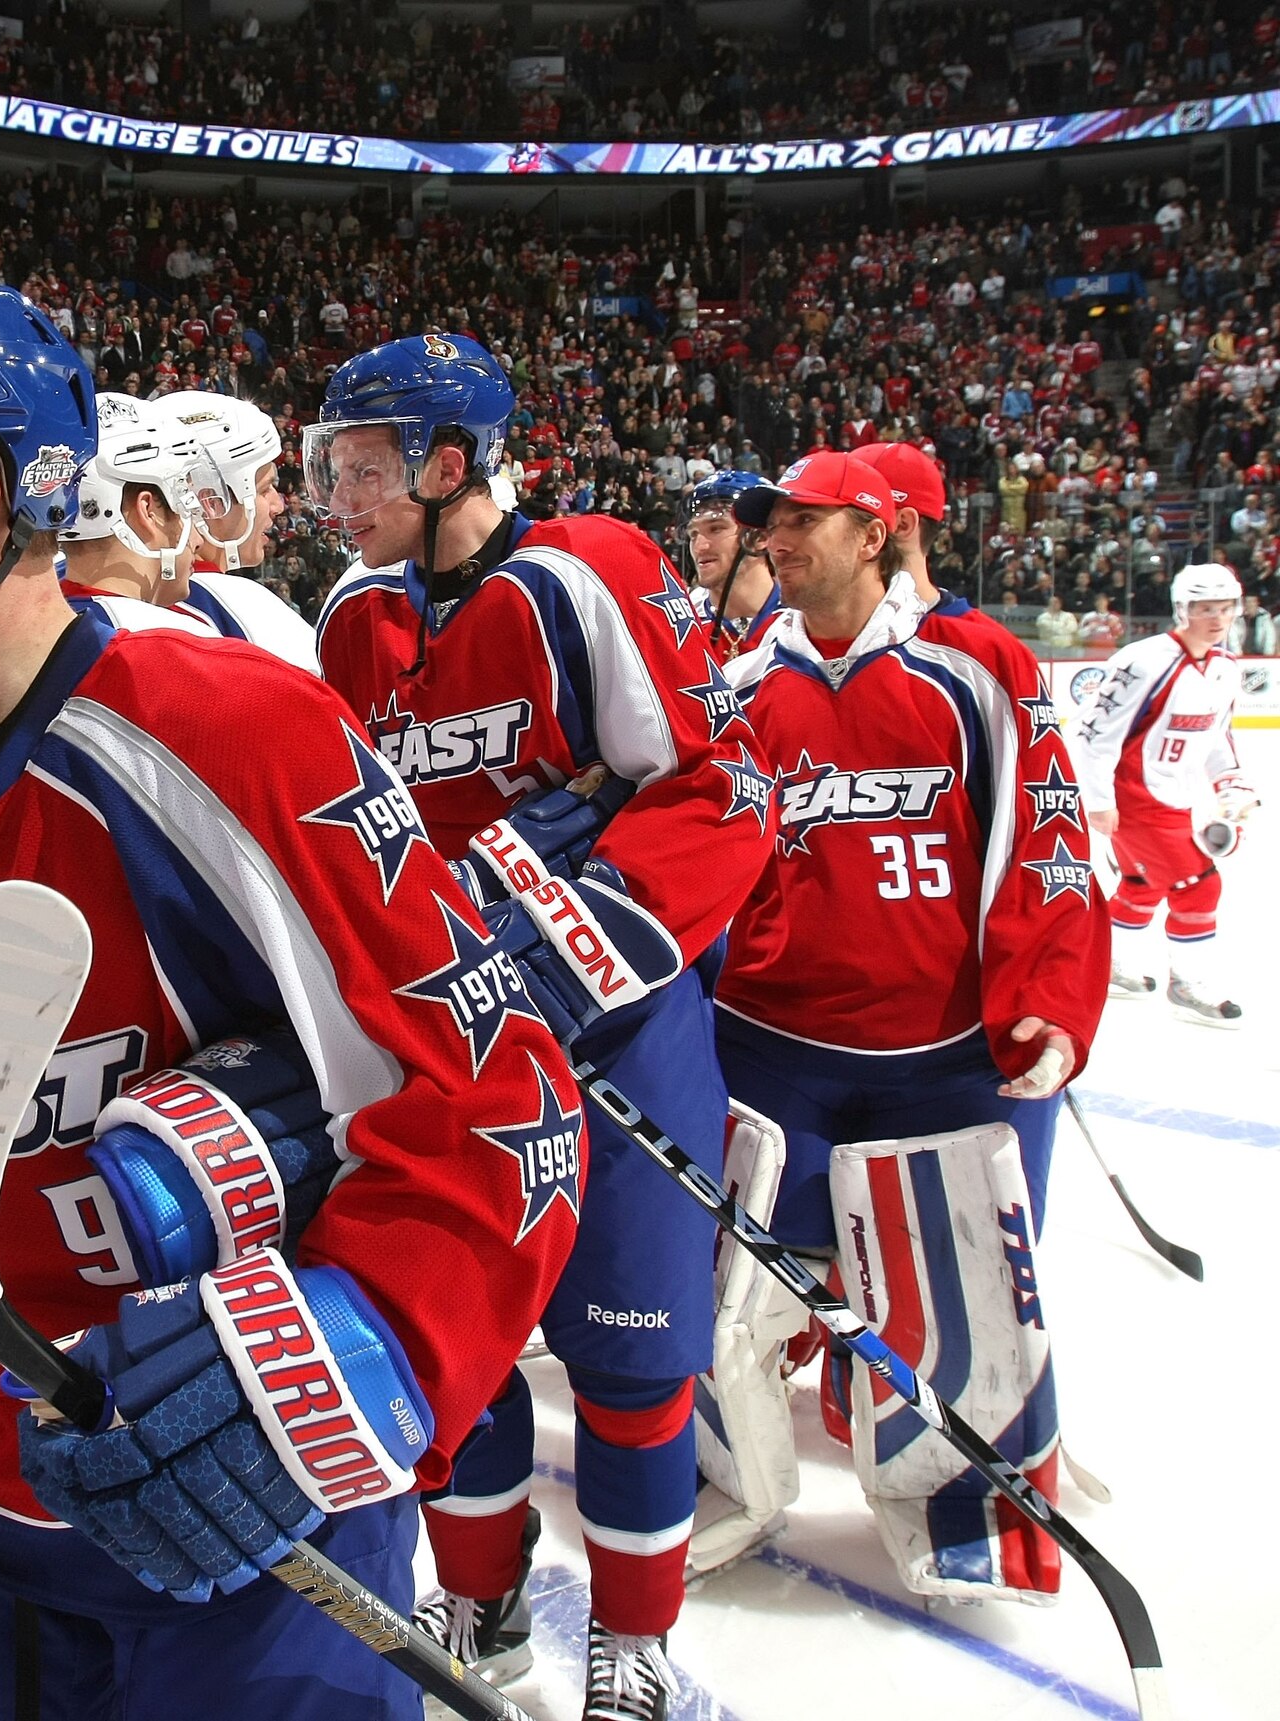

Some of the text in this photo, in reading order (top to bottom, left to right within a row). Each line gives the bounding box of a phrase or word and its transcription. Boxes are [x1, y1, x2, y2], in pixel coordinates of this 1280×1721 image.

[119, 127, 171, 150] DES
[1075, 276, 1109, 296] Bell
[593, 298, 620, 315] Bell
[36, 462, 63, 471] MATCH
[663, 599, 695, 622] 196
[378, 703, 525, 779] EAST
[1158, 736, 1187, 763] 19
[734, 771, 768, 806] 1993
[781, 768, 952, 826] EAST
[1037, 789, 1077, 811] 1975
[353, 787, 416, 849] 196
[869, 832, 952, 900] 35
[1044, 865, 1088, 885] 1993
[531, 880, 628, 998] STON
[448, 950, 522, 1024] 1975
[524, 1130, 578, 1188] 1993
[587, 1303, 671, 1329] Reebok
[389, 1397, 420, 1446] SAVARD
[373, 1597, 411, 1633] SAVARD
